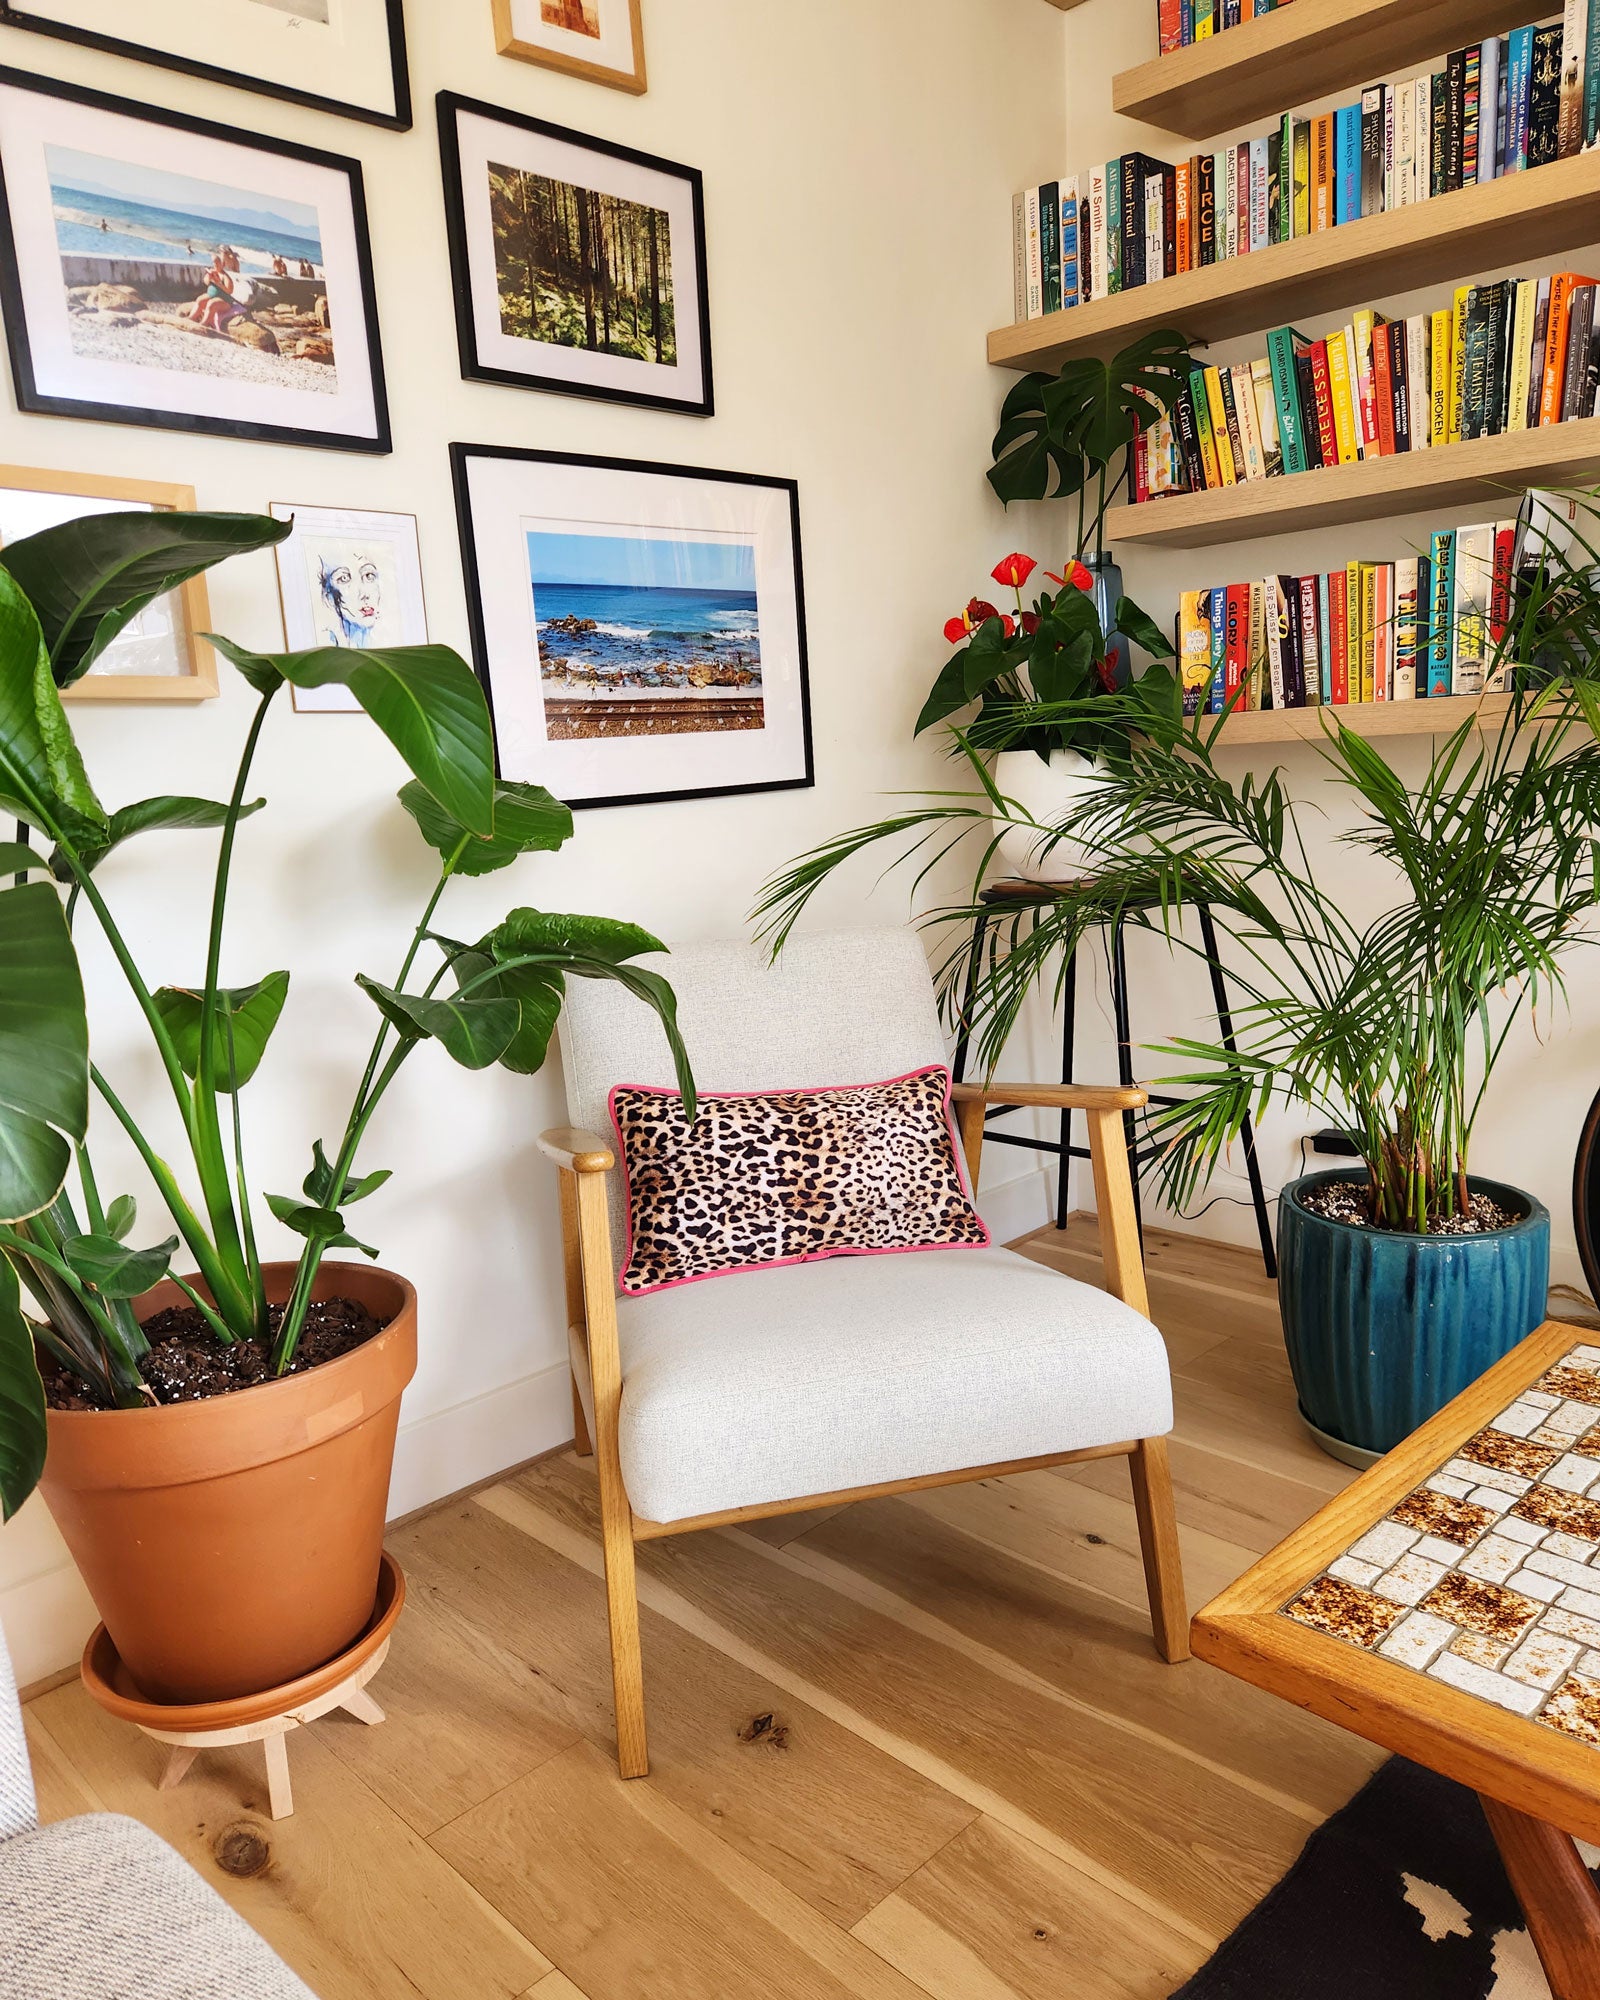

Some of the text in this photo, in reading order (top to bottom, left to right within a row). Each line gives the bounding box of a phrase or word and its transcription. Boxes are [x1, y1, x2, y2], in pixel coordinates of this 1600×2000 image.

[1508, 61, 1519, 149] SHEHAN KARUNATILAKA
[1519, 75, 1527, 103] MOONS
[1418, 82, 1427, 136] SOCIAL CREATURE
[1448, 63, 1460, 176] The Discomfort of Evening
[1519, 105, 1526, 116] OF
[1559, 101, 1569, 153] OMISSION
[1317, 119, 1327, 149] BARBARA
[1344, 111, 1356, 169] marian keyes
[1371, 114, 1379, 160] SHUGGIE
[1433, 102, 1446, 173] The Leviathan
[1570, 131, 1577, 140] OF
[1227, 149, 1236, 216] RACHEL CUSK
[1317, 149, 1327, 185] KINGSOLVER
[1094, 178, 1102, 193] Ali
[1109, 167, 1119, 216] Ali Smith
[1125, 159, 1136, 238] Esther Freud
[1176, 169, 1187, 221] MAGPIE
[1200, 158, 1214, 243] CIRCE
[1257, 166, 1266, 235] KATE ATKINSON
[1094, 196, 1103, 232] Smith
[1239, 215, 1247, 226] Mia
[1520, 295, 1528, 319] Sweetness
[1552, 316, 1560, 329] THE
[1553, 302, 1562, 315] ALL
[1375, 329, 1385, 350] MIRIAM
[1457, 319, 1466, 342] Pascoe
[1486, 305, 1498, 371] INHERITANCE
[1550, 329, 1558, 345] WAY
[1275, 335, 1289, 396] RICHARD OSMAN
[1376, 350, 1387, 372] TOEWS
[1456, 350, 1466, 366] Sex
[1470, 321, 1486, 413] N. K. JEMISIN
[1332, 341, 1350, 448] FLIGHTS OLGA TOKARCZUK
[1379, 374, 1388, 386] ALL
[1380, 387, 1389, 398] MY
[1434, 318, 1444, 436] JENNY LAWSON BROKEN
[1454, 369, 1465, 398] Power
[1546, 368, 1555, 387] JOHN
[1565, 374, 1575, 409] BONDAGE
[1195, 389, 1203, 412] Rabbit
[1310, 397, 1318, 421] KILLING
[1364, 389, 1375, 440] peace adzo medie
[1400, 384, 1408, 435] CONVERSATIONS
[1484, 373, 1495, 421] TRILOGY
[1512, 397, 1522, 421] Bradley
[1544, 389, 1554, 412] GREEN
[1178, 403, 1193, 441] Grant
[1198, 413, 1207, 435] Hutch
[1382, 415, 1391, 444] SORROWS
[1450, 402, 1463, 434] Money
[1202, 441, 1210, 455] Tess
[1226, 416, 1243, 470] My Country
[1282, 415, 1300, 471] Bullet MISSED
[1204, 455, 1212, 476] Gunty
[1463, 538, 1475, 604] GALBRAITH
[1491, 545, 1507, 629] Guide Murder
[1302, 595, 1315, 631] END
[1320, 580, 1328, 610] PENELOPE
[1397, 589, 1417, 628] THE
[1433, 534, 1453, 662] WELLNESS
[1213, 591, 1224, 658] Things They
[1227, 601, 1238, 647] GLORY
[1252, 586, 1261, 651] WASHINGTON BLACK
[1266, 585, 1283, 695] Big Swiss Jen Beagin
[1304, 639, 1318, 662] NIGHT
[1365, 640, 1375, 660] DEAD
[1396, 633, 1417, 671] NIX
[1457, 616, 1470, 658] GRAVE
[1365, 660, 1374, 680] LIONS
